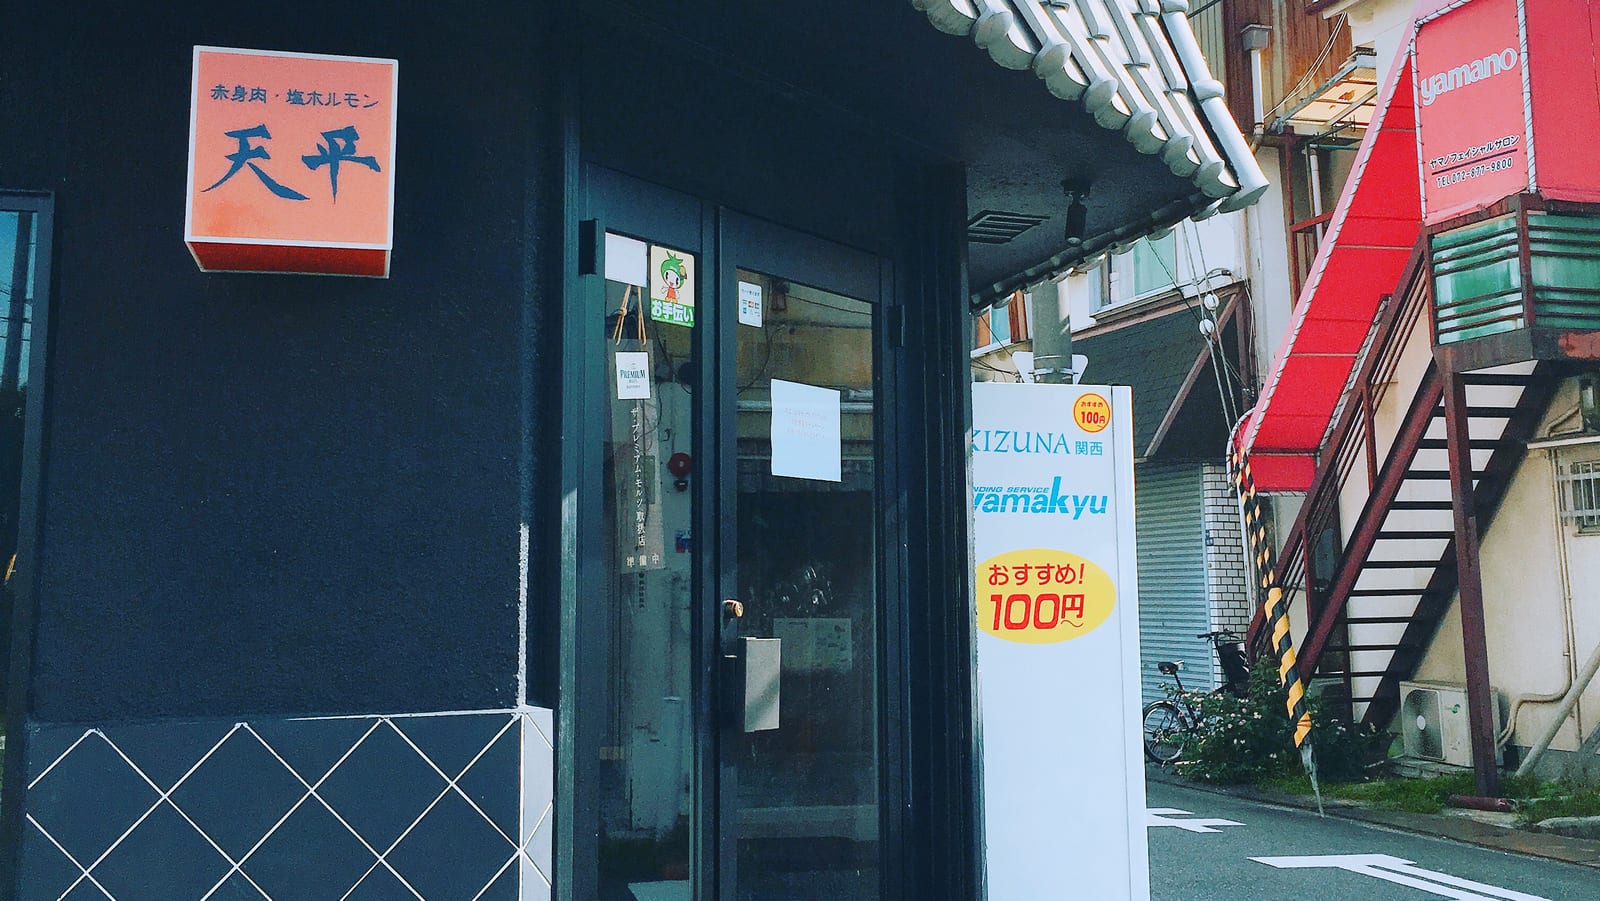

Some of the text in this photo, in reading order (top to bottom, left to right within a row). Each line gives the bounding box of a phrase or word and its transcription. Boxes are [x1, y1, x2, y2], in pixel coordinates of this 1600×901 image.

[1420, 47, 1518, 106] yamano
[210, 83, 379, 108] 赤身肉・塩ホルモン
[1429, 135, 1520, 169] ヤマノフェイシャルサロン
[201, 124, 381, 205] 天平
[1436, 174, 1451, 188] TEL
[651, 299, 694, 323] お手伝い
[619, 369, 646, 379] PREMIUM
[1075, 440, 1103, 456] 関西
[1007, 486, 1050, 494] SERVICE
[988, 563, 1085, 586] おすすめ!
